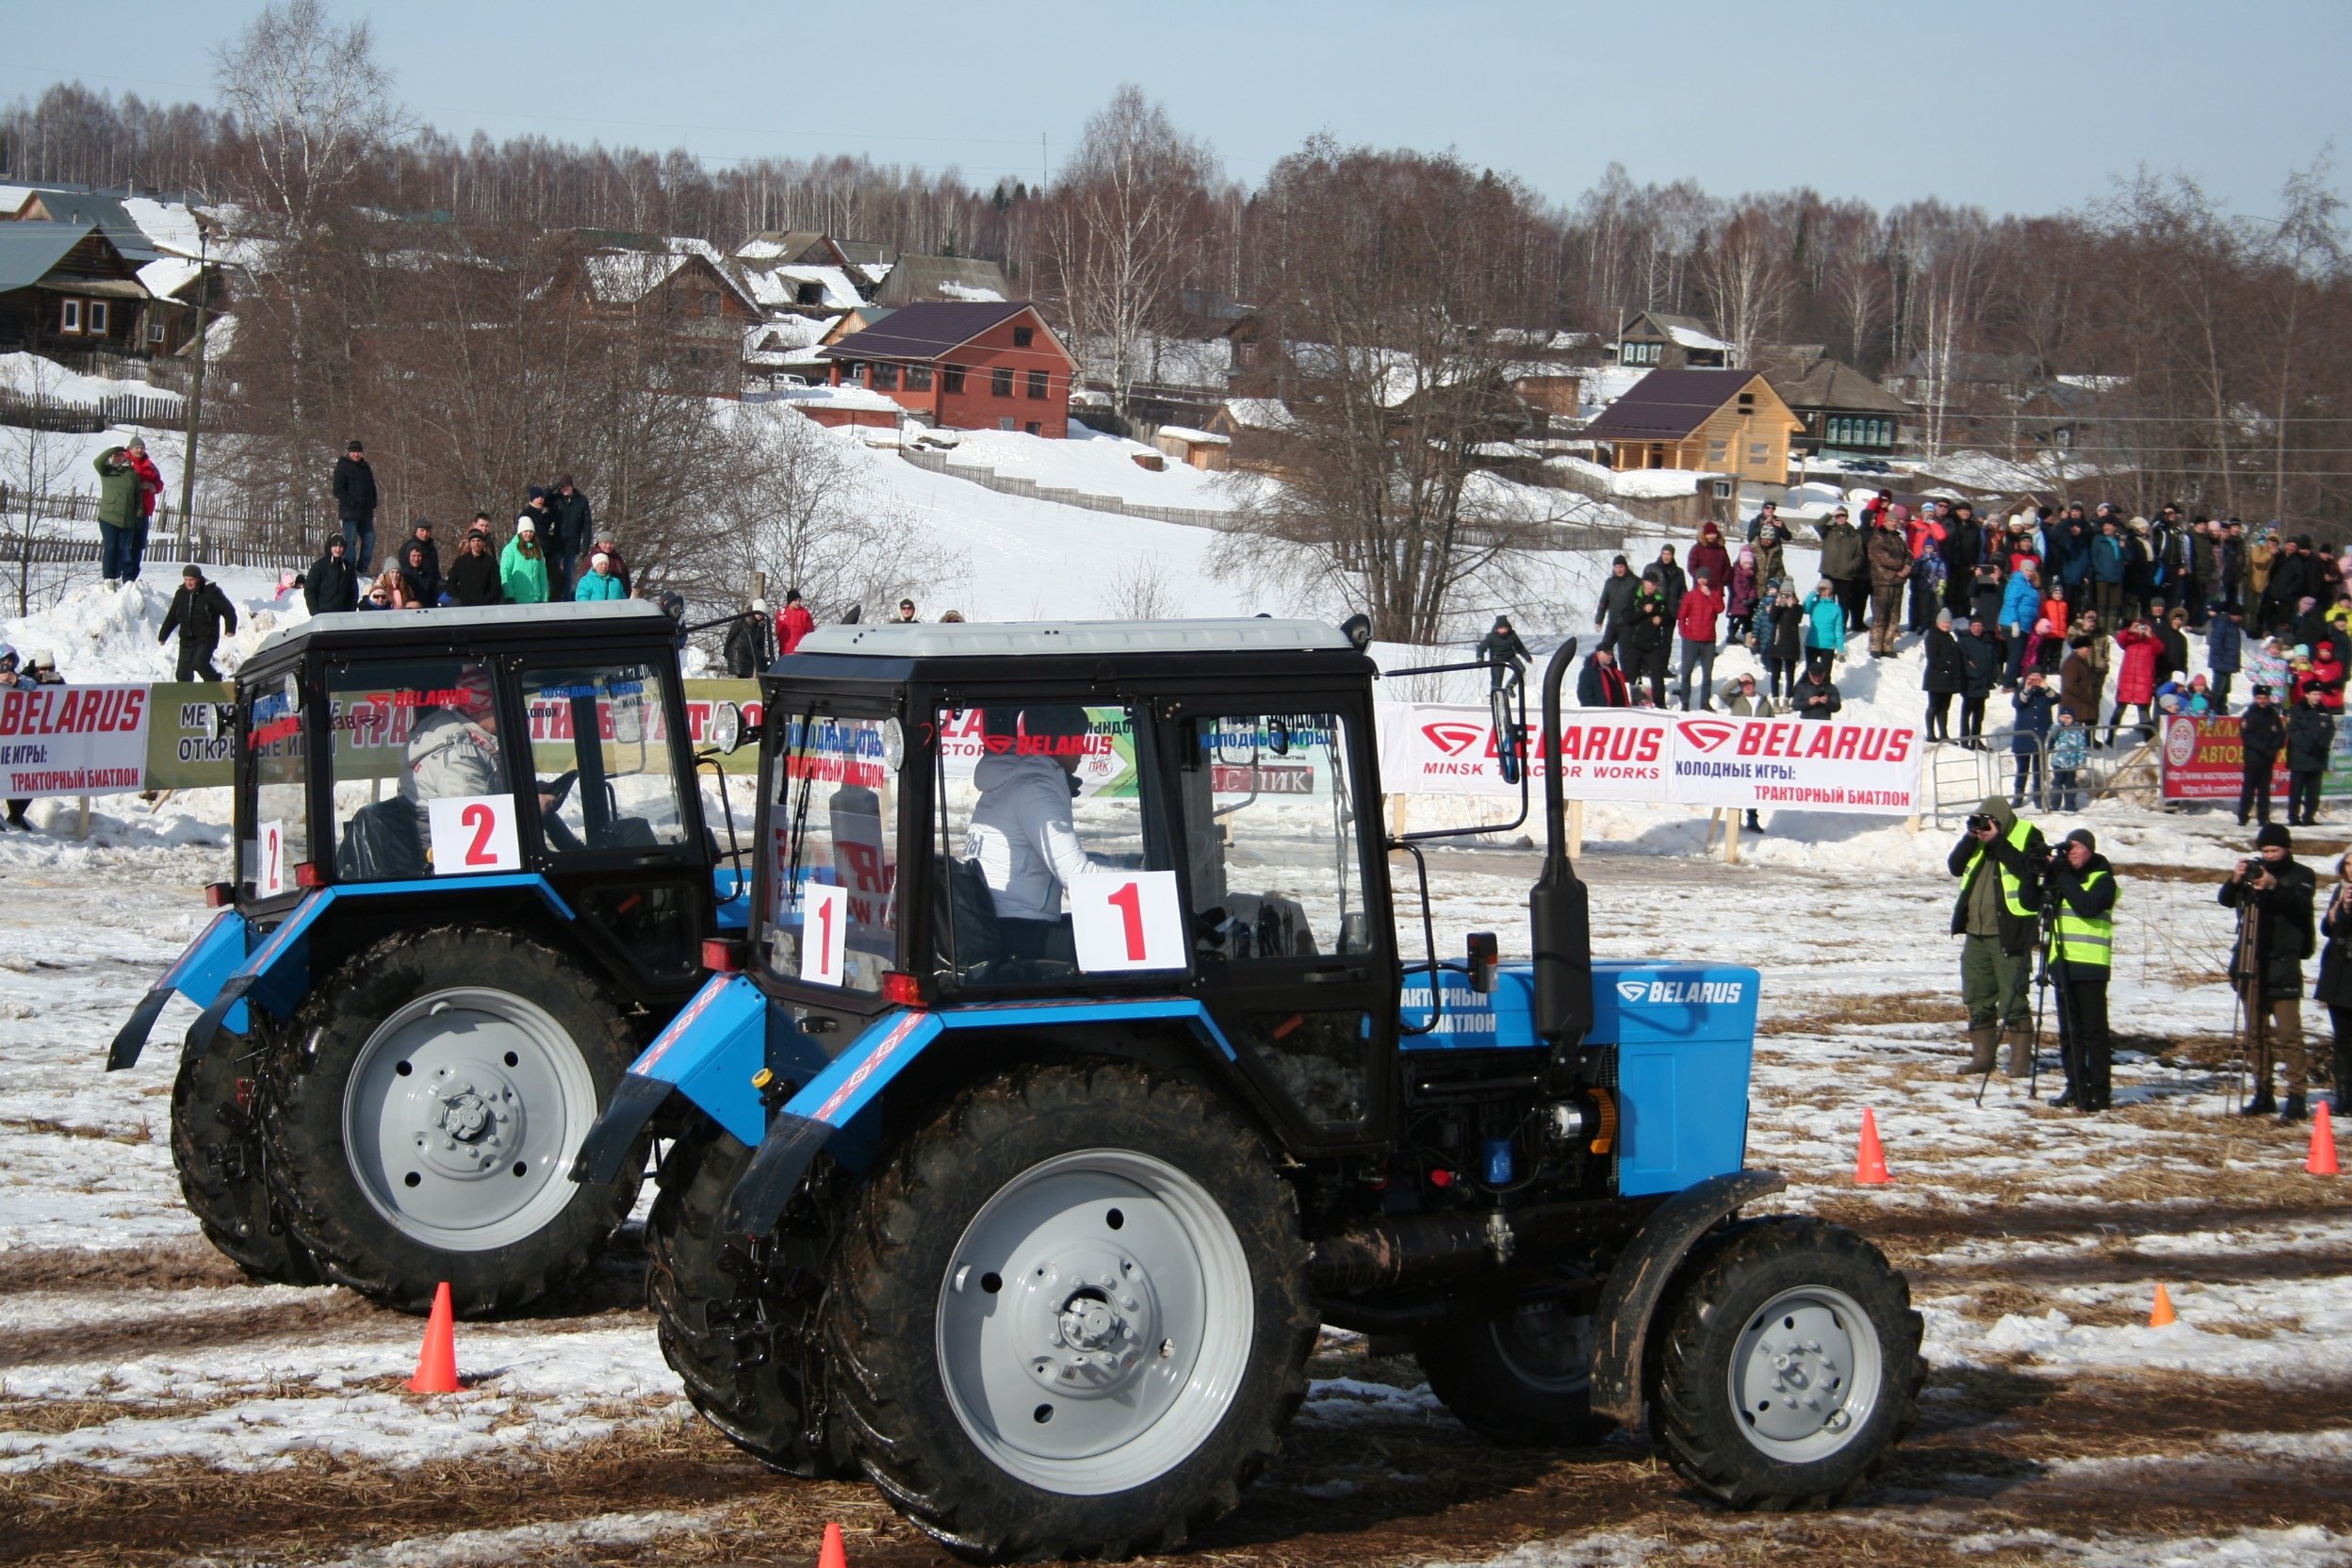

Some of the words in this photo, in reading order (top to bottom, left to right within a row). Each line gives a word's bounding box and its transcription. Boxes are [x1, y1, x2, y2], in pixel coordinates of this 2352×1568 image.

[393, 689, 472, 707] BELARUS
[0, 689, 145, 735] BELARUS
[789, 723, 850, 754] ХООДНЫЕ
[1016, 735, 1113, 756] BELARUS
[1737, 722, 1914, 762] BELARUS
[12, 744, 47, 764] ИГРЫ:
[11, 766, 85, 792] ТРАКТОРНЫЙ
[88, 768, 139, 788] БИАТЛОН
[1423, 762, 1484, 776] MINSK
[1593, 766, 1659, 779] WORKS
[1675, 760, 1752, 779] ХОЛОДНЫЕ
[1755, 764, 1796, 780] ИГРЫ:
[1755, 785, 1844, 804] ТРАКТОРНЫЙ
[1848, 790, 1909, 807] БИАТЛОН
[461, 804, 498, 865] 2
[270, 828, 278, 890] 2
[1108, 882, 1146, 961] 1
[818, 897, 832, 975] 1
[1647, 981, 1742, 1004] BELARUS
